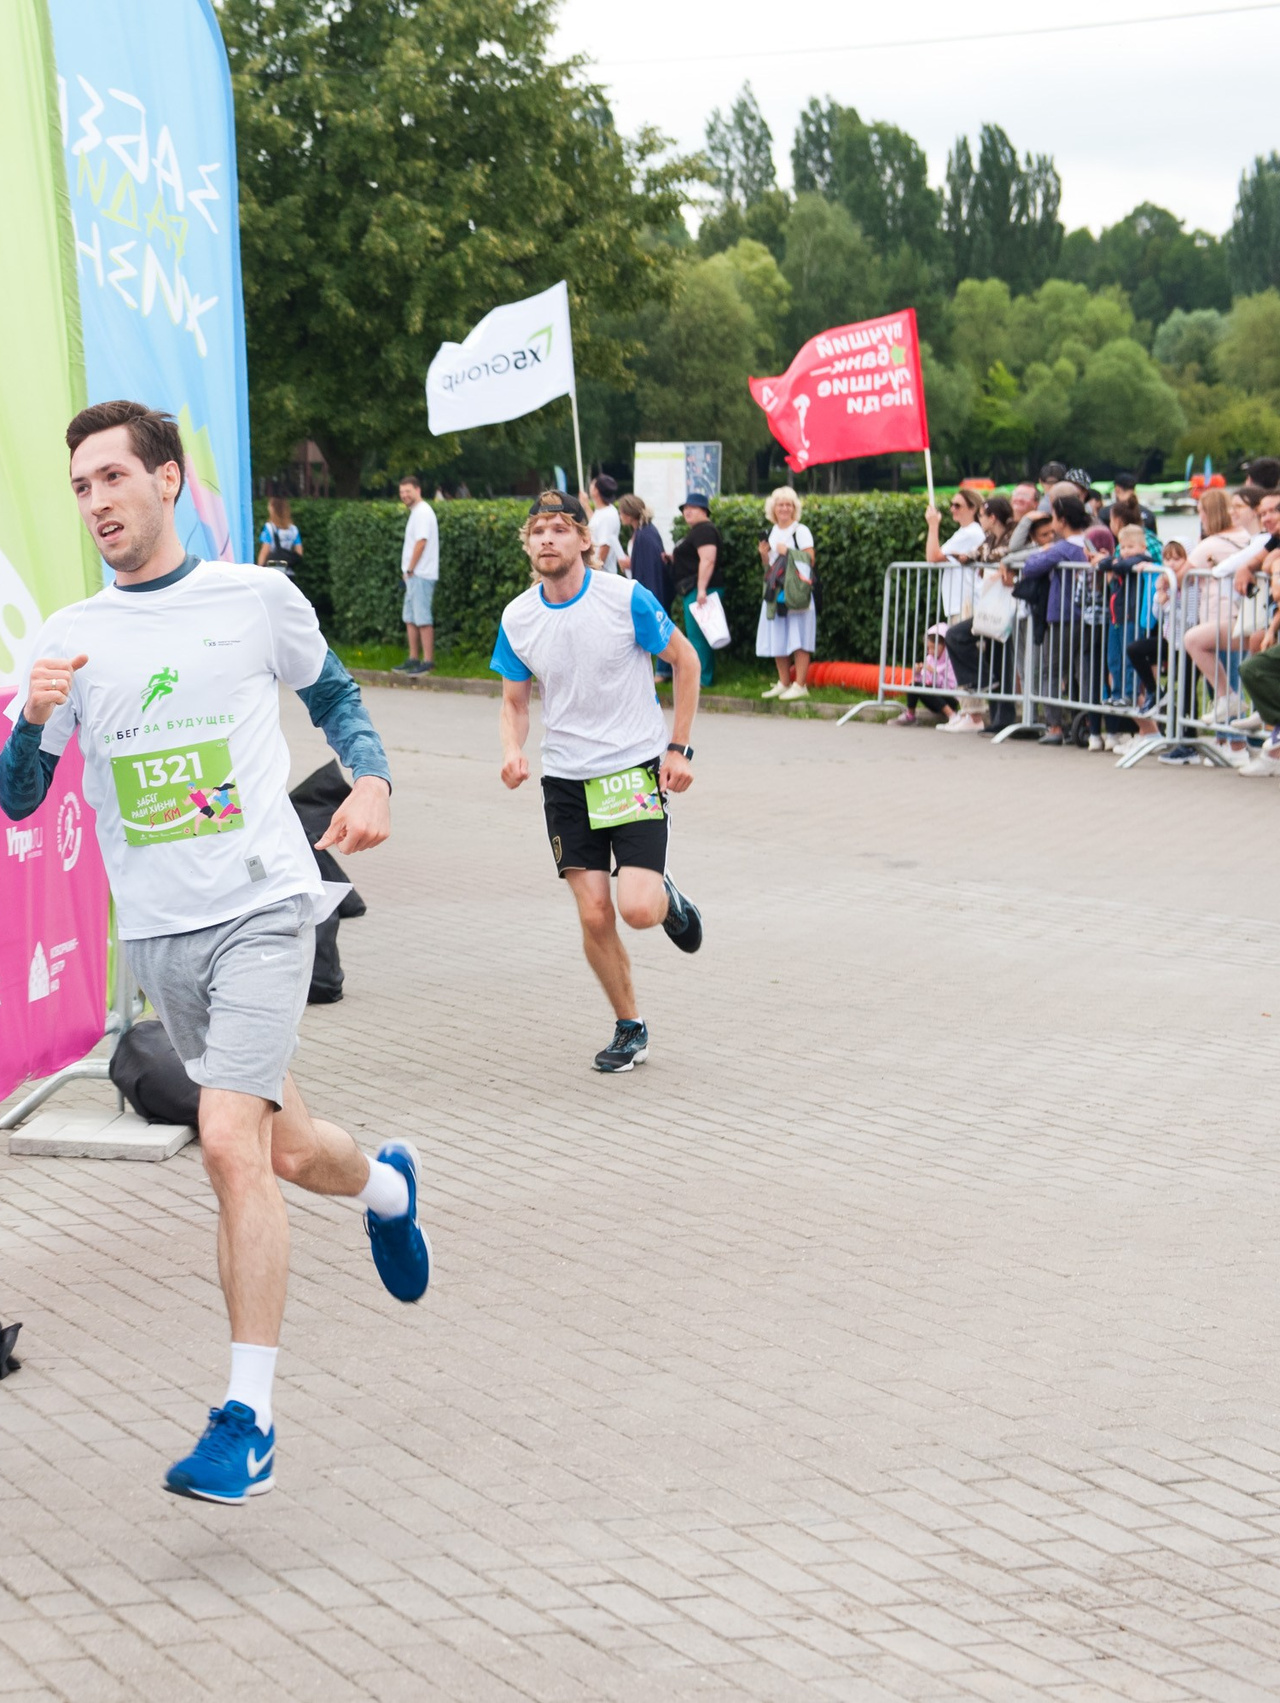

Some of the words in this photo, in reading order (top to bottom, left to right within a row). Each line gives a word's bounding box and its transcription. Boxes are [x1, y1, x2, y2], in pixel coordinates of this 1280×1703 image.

[104, 727, 139, 744] ЗАБЕГ
[144, 723, 161, 734] ЗА
[167, 713, 236, 731] БУДУЩЕЕ
[132, 752, 204, 789] 1321
[599, 771, 645, 796] 1015
[131, 807, 149, 819] РАДИ
[136, 793, 158, 808] ЗАБЕГ
